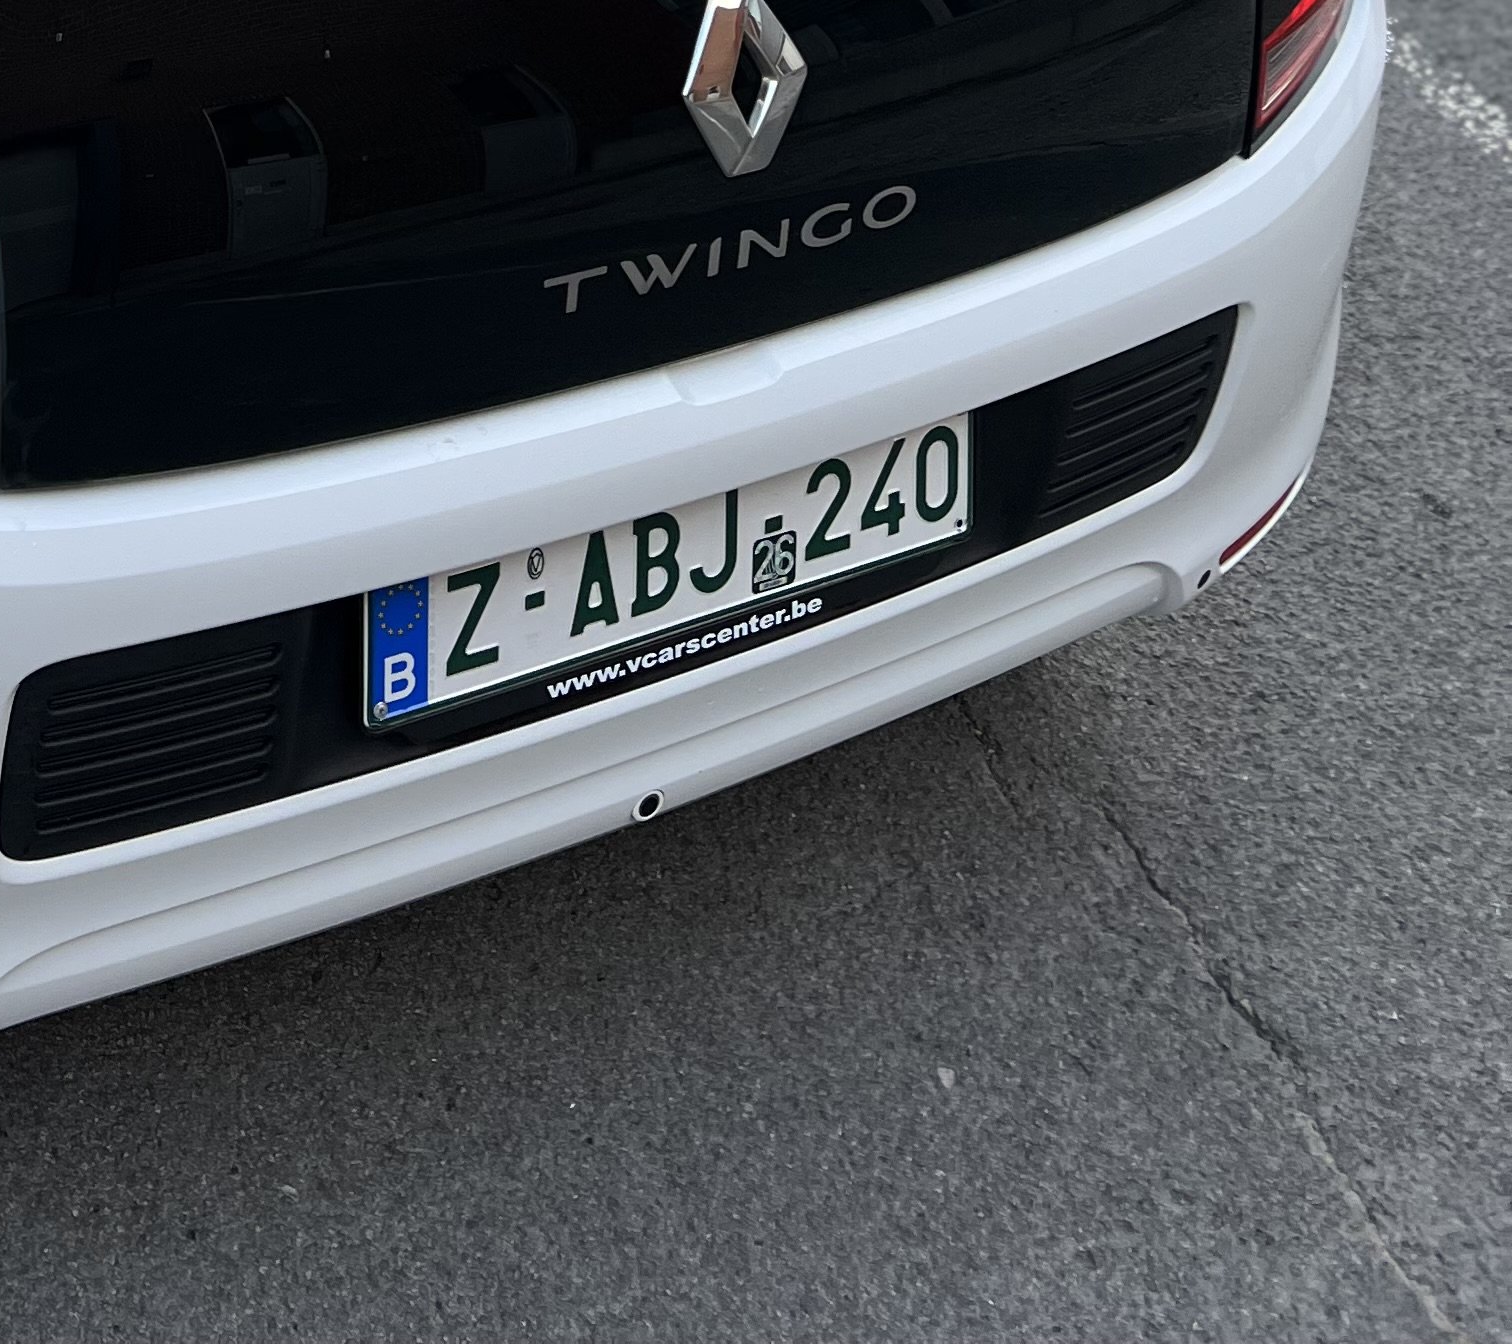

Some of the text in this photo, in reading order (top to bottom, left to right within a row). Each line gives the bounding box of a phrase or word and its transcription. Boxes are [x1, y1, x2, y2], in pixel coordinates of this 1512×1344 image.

[543, 185, 917, 314] TWINGO
[383, 652, 416, 704] B
[546, 597, 823, 699] www.vcarscenter.be
